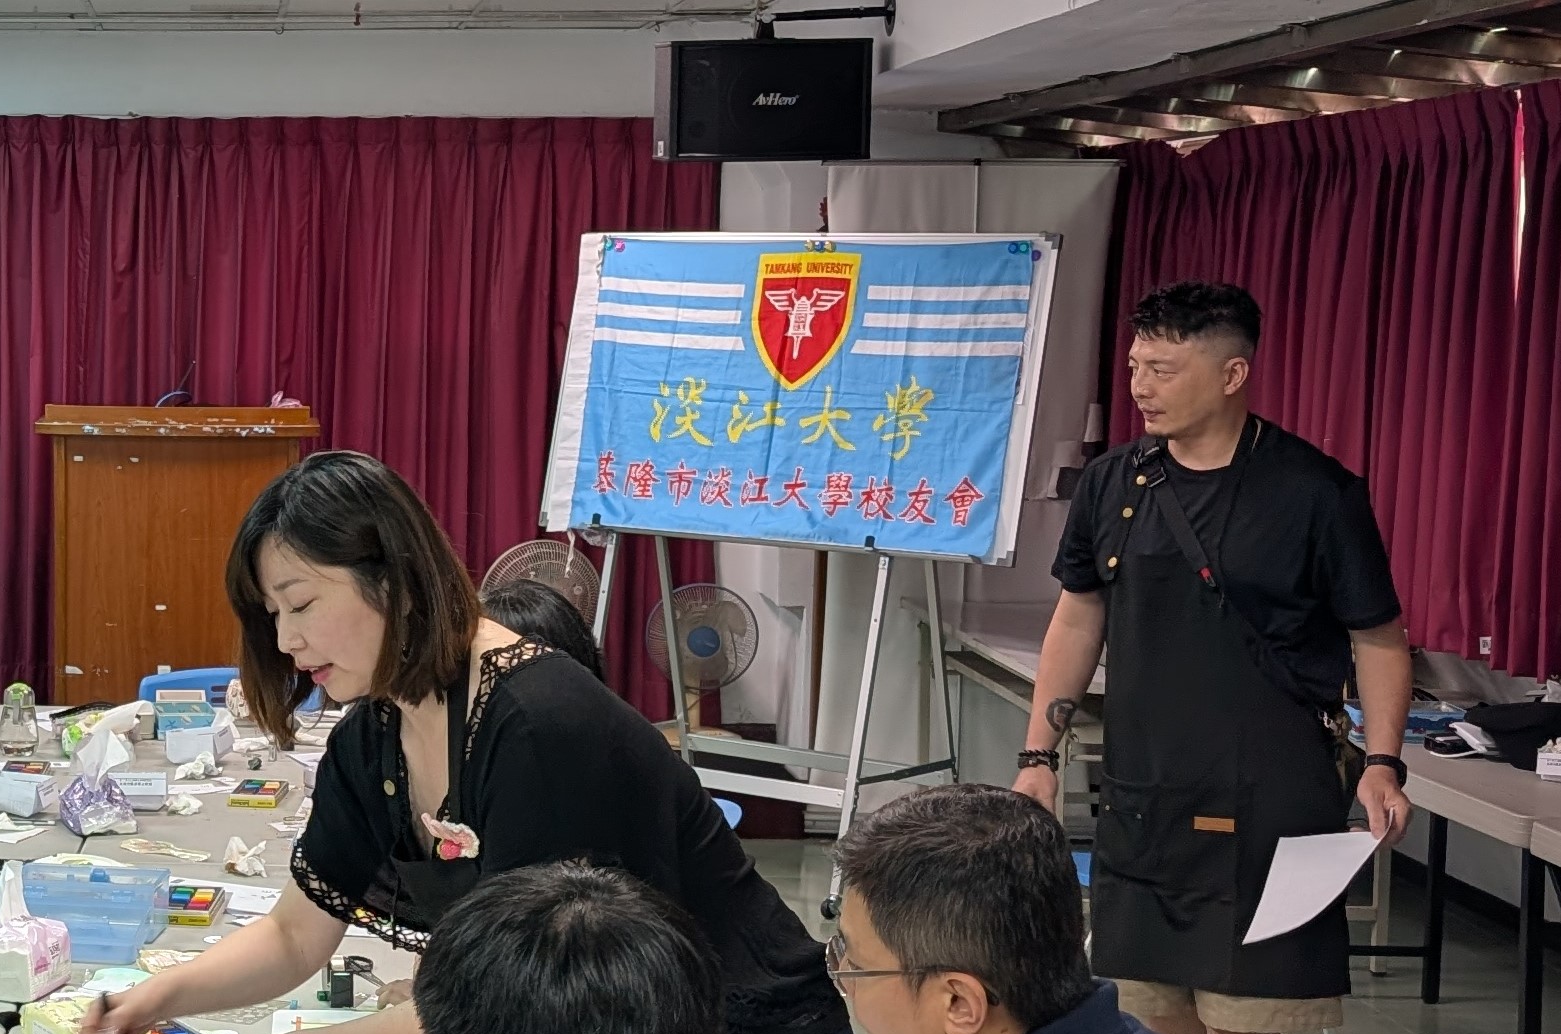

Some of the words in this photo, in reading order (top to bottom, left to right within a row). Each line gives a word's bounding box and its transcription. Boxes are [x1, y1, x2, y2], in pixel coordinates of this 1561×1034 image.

[765, 262, 802, 275] TAMKANG
[806, 262, 854, 275] UNIVERSITY
[650, 375, 935, 461] 淡江大學
[591, 450, 985, 528] 基隆市淡江大學校友會
